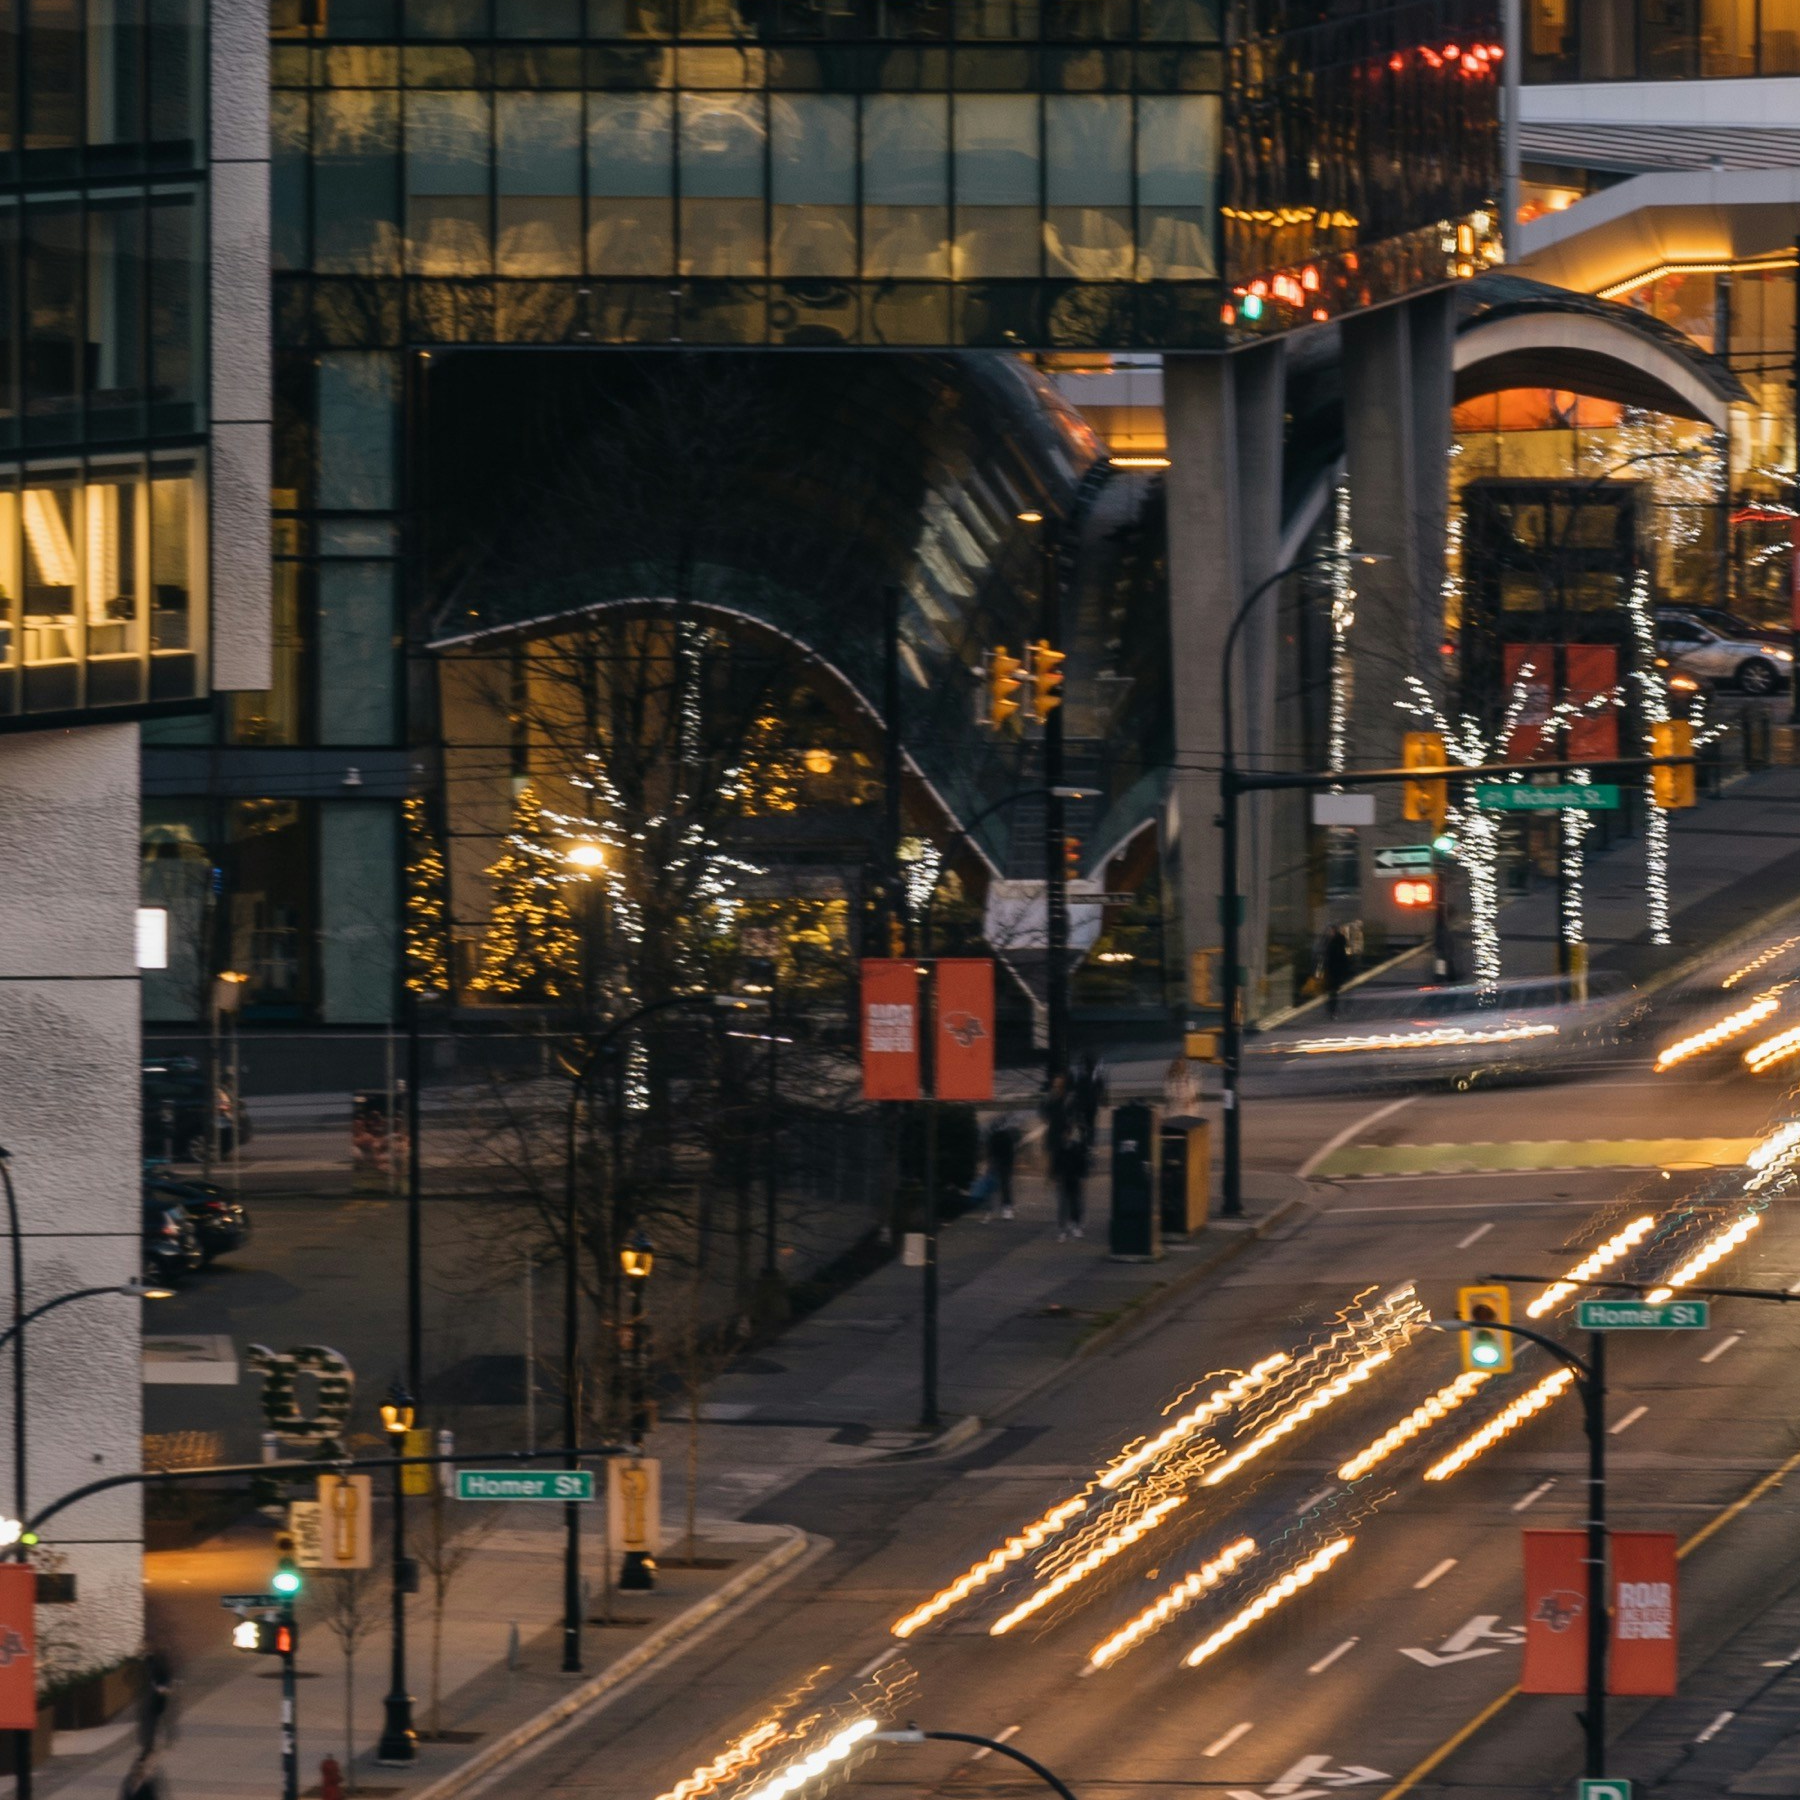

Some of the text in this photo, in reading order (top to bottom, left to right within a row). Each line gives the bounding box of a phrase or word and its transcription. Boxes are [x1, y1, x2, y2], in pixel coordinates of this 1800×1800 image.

[1512, 789, 1580, 805] Richards
[1588, 1305, 1698, 1324] Homer St
[467, 1475, 582, 1495] Homer St
